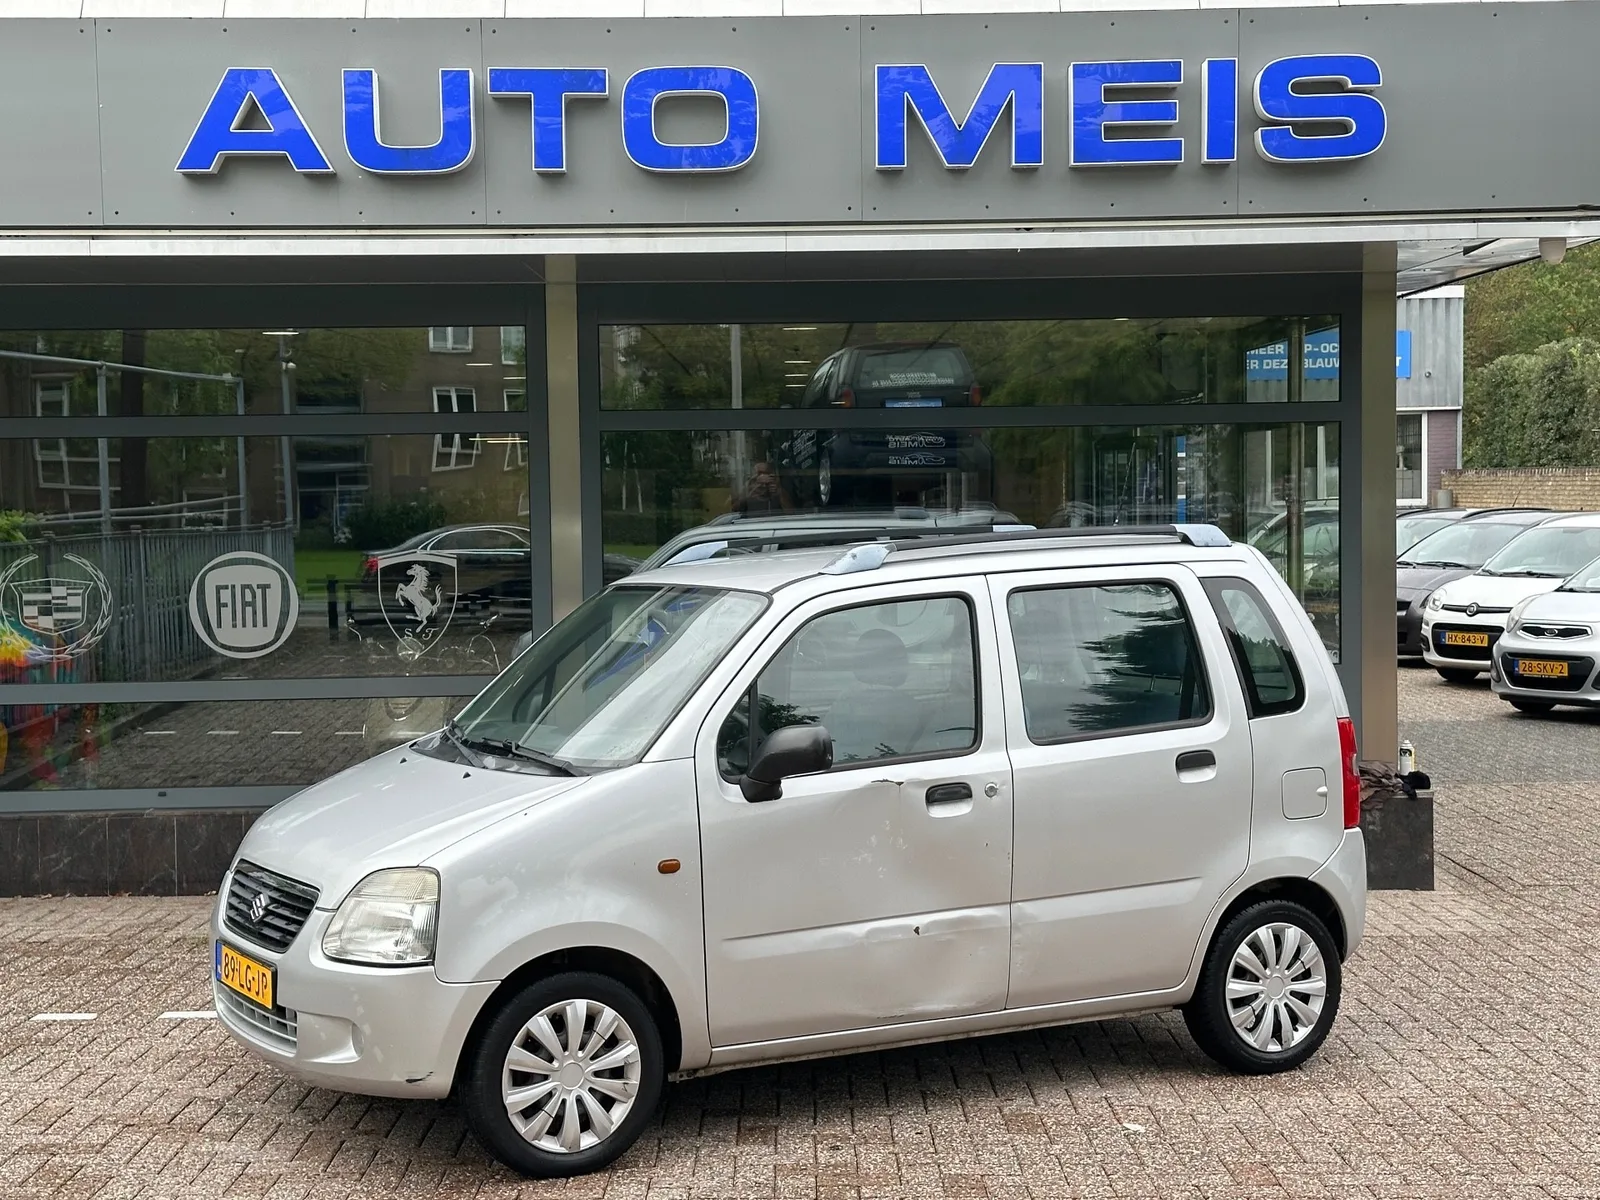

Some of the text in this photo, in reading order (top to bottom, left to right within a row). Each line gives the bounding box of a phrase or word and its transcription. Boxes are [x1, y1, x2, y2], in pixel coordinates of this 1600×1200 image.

[174, 53, 1388, 174] AUTO MEIS
[215, 583, 271, 629] FIAT
[1447, 633, 1485, 645] HX-843-V
[1521, 661, 1565, 675] 28-SKV-2
[224, 952, 268, 999] 89-LG-JP
